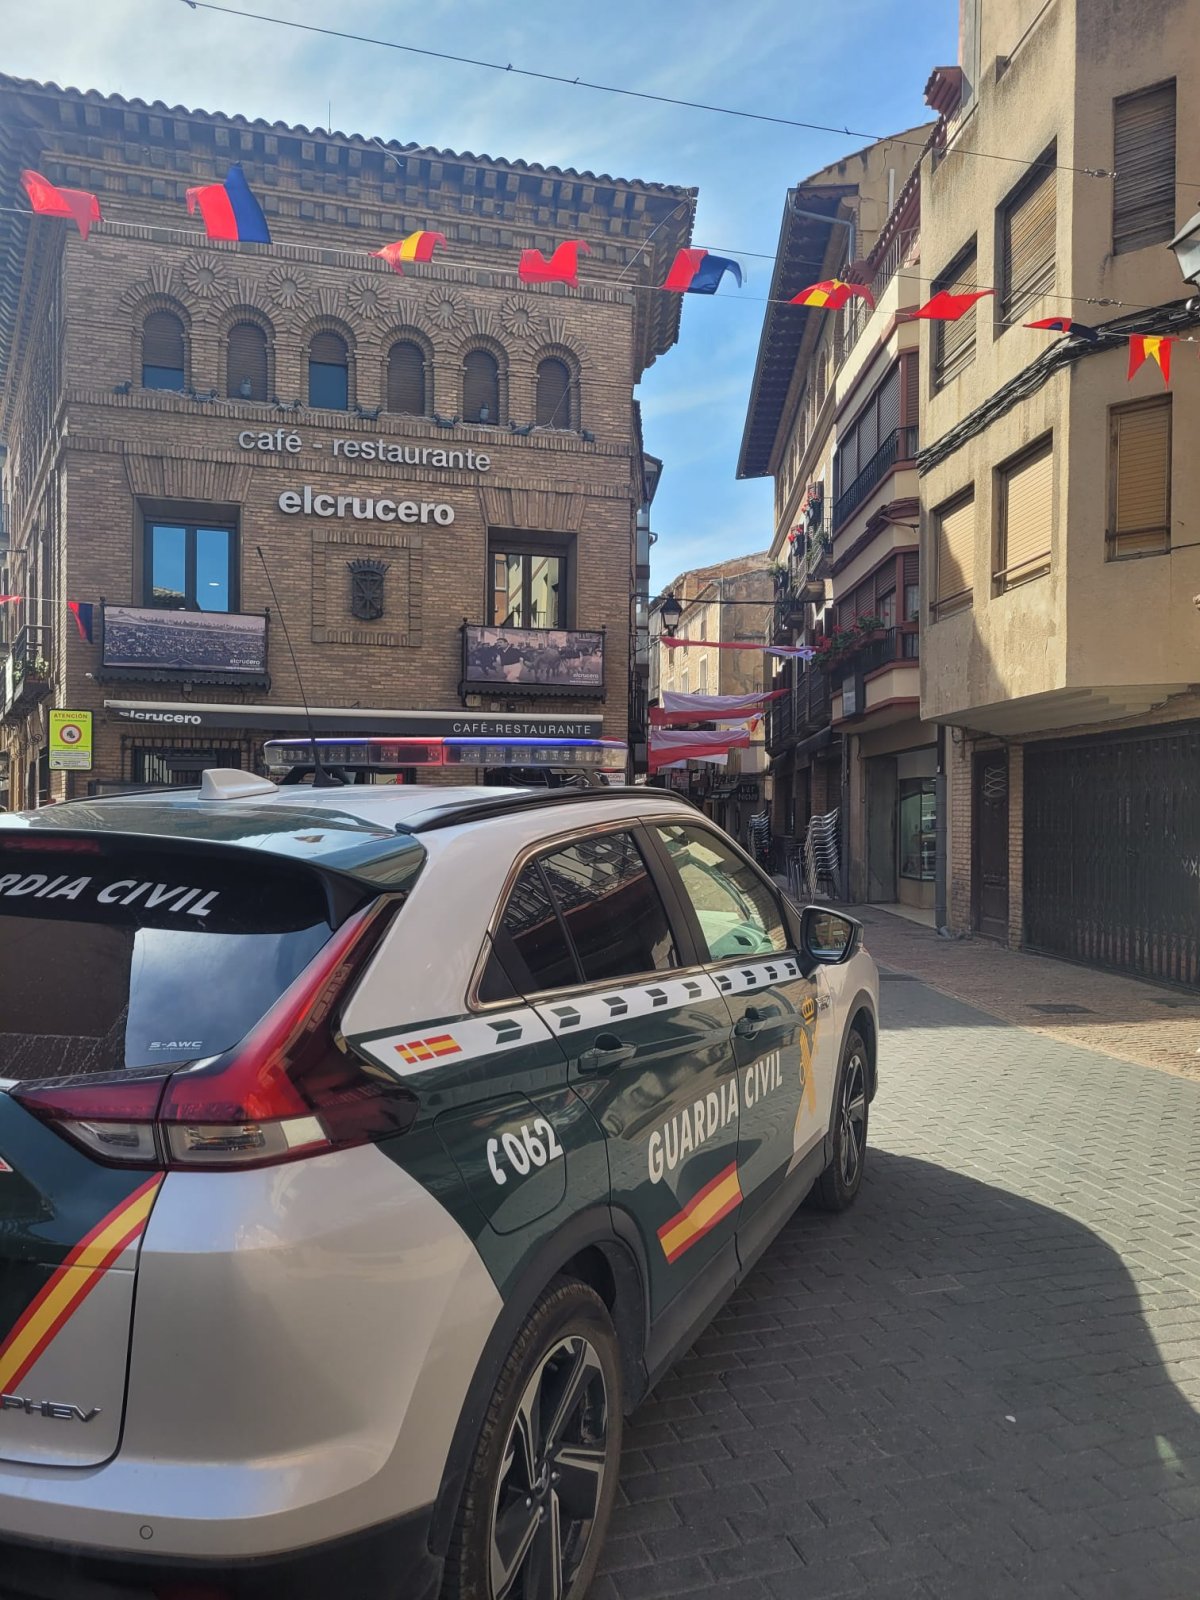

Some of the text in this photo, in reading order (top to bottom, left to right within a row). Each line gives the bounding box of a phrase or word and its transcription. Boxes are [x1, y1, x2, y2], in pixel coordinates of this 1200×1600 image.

[238, 428, 302, 453] café
[332, 438, 491, 472] restaurante
[278, 485, 455, 526] elcrucero
[452, 722, 592, 735] CAFÉ-RESTAURANTE
[96, 879, 220, 917] CIVIL
[648, 1051, 783, 1184] GUARDIA CIVIL
[501, 1118, 564, 1176] 062
[1, 1394, 101, 1422] PHEV
